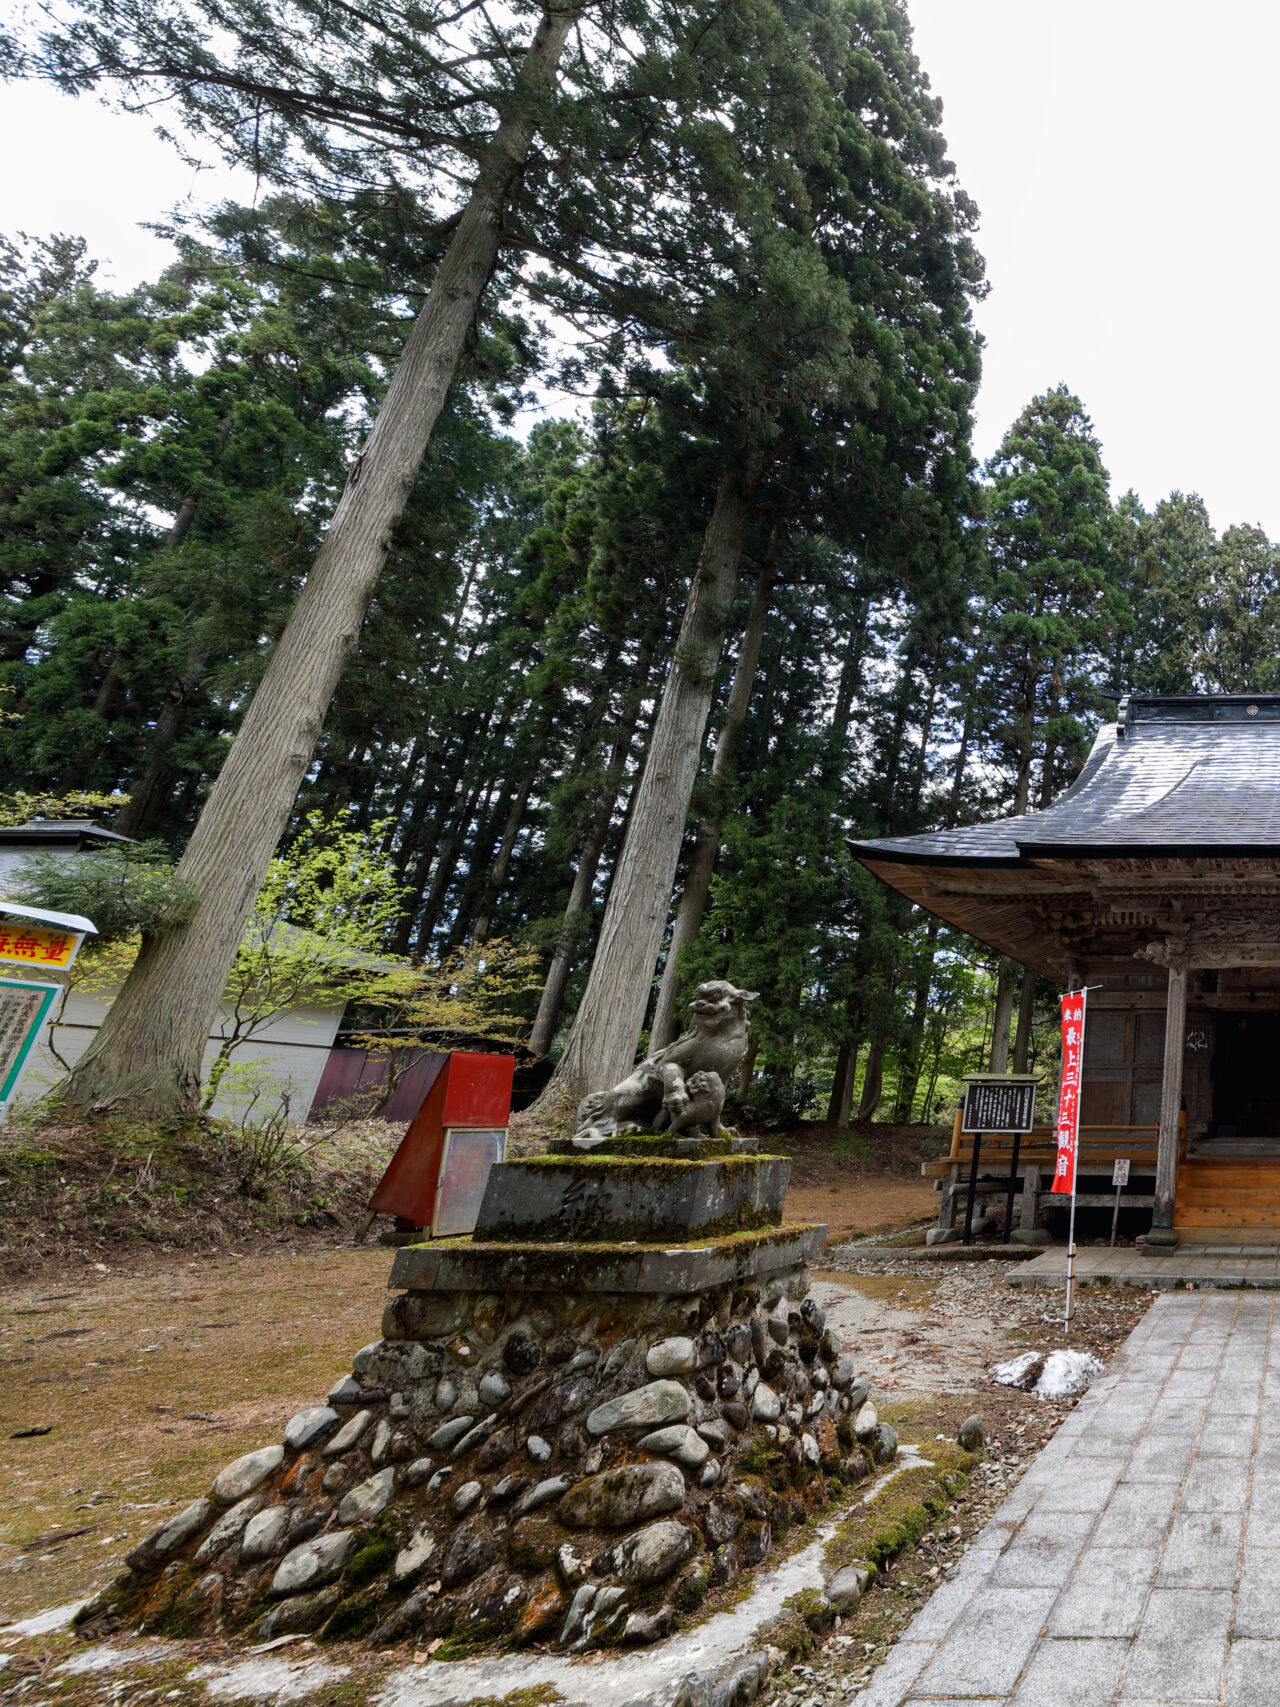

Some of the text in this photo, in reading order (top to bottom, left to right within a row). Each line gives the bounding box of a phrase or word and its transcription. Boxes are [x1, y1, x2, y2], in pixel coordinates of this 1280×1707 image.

[1063, 1008, 1082, 1023] 奉納
[1057, 1026, 1077, 1177] 最上三十三観音
[1114, 1159, 1128, 1184] 禁煙
